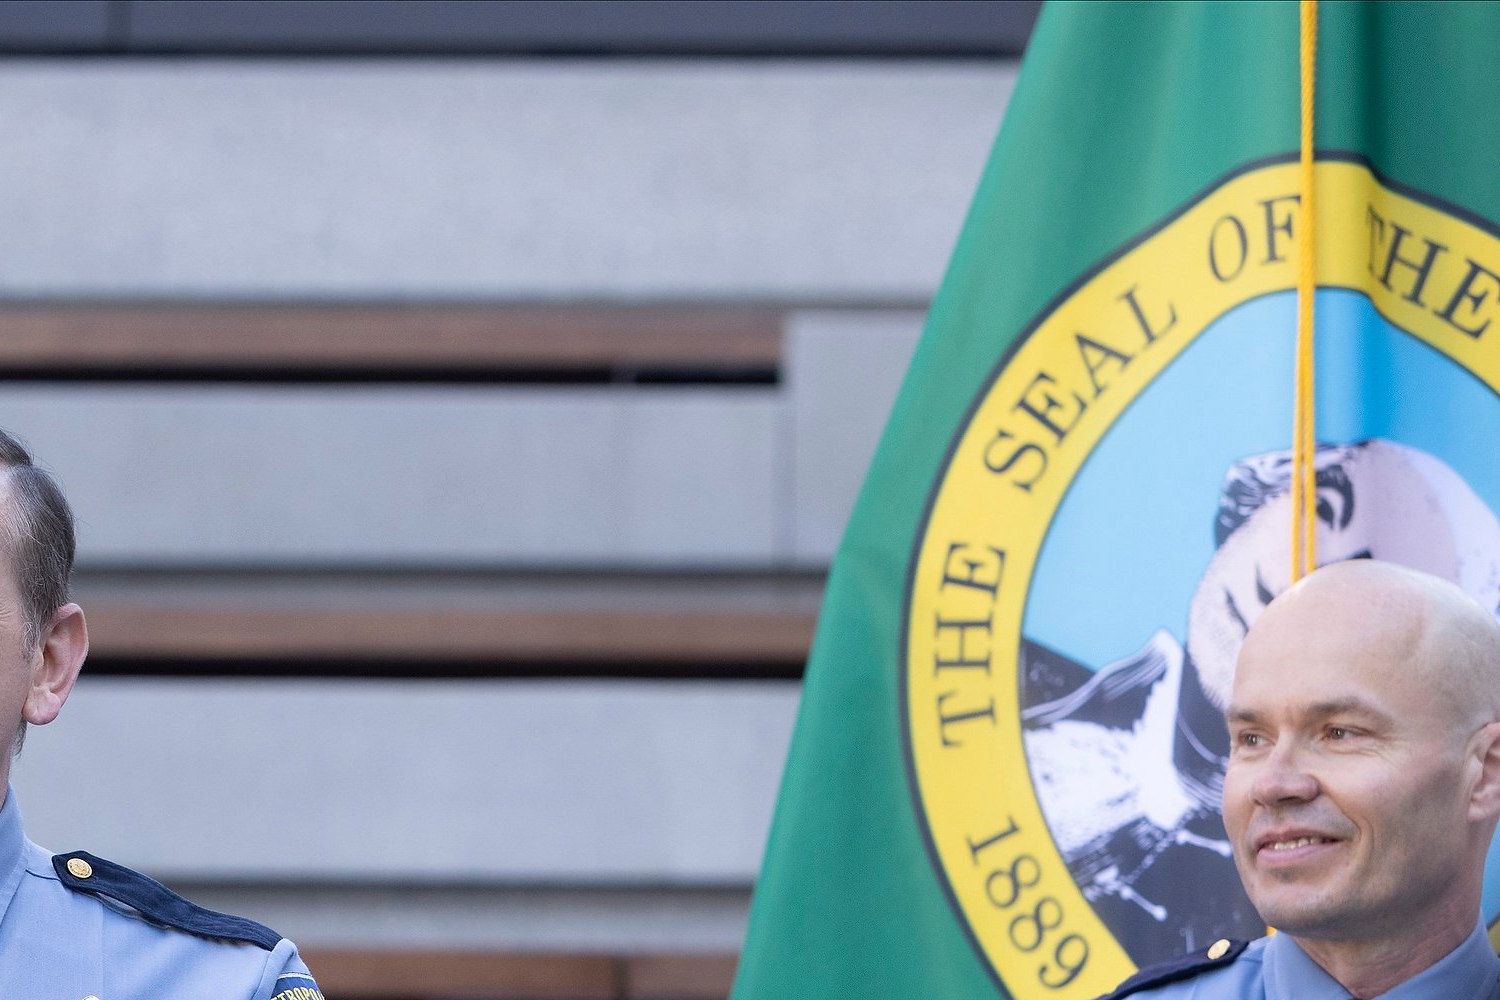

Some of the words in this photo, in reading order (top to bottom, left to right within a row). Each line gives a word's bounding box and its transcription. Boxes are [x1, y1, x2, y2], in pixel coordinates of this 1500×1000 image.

[934, 541, 1007, 749] THE
[983, 284, 1178, 493] SEAL
[1207, 193, 1302, 284] OF
[966, 815, 1090, 990] 1889
